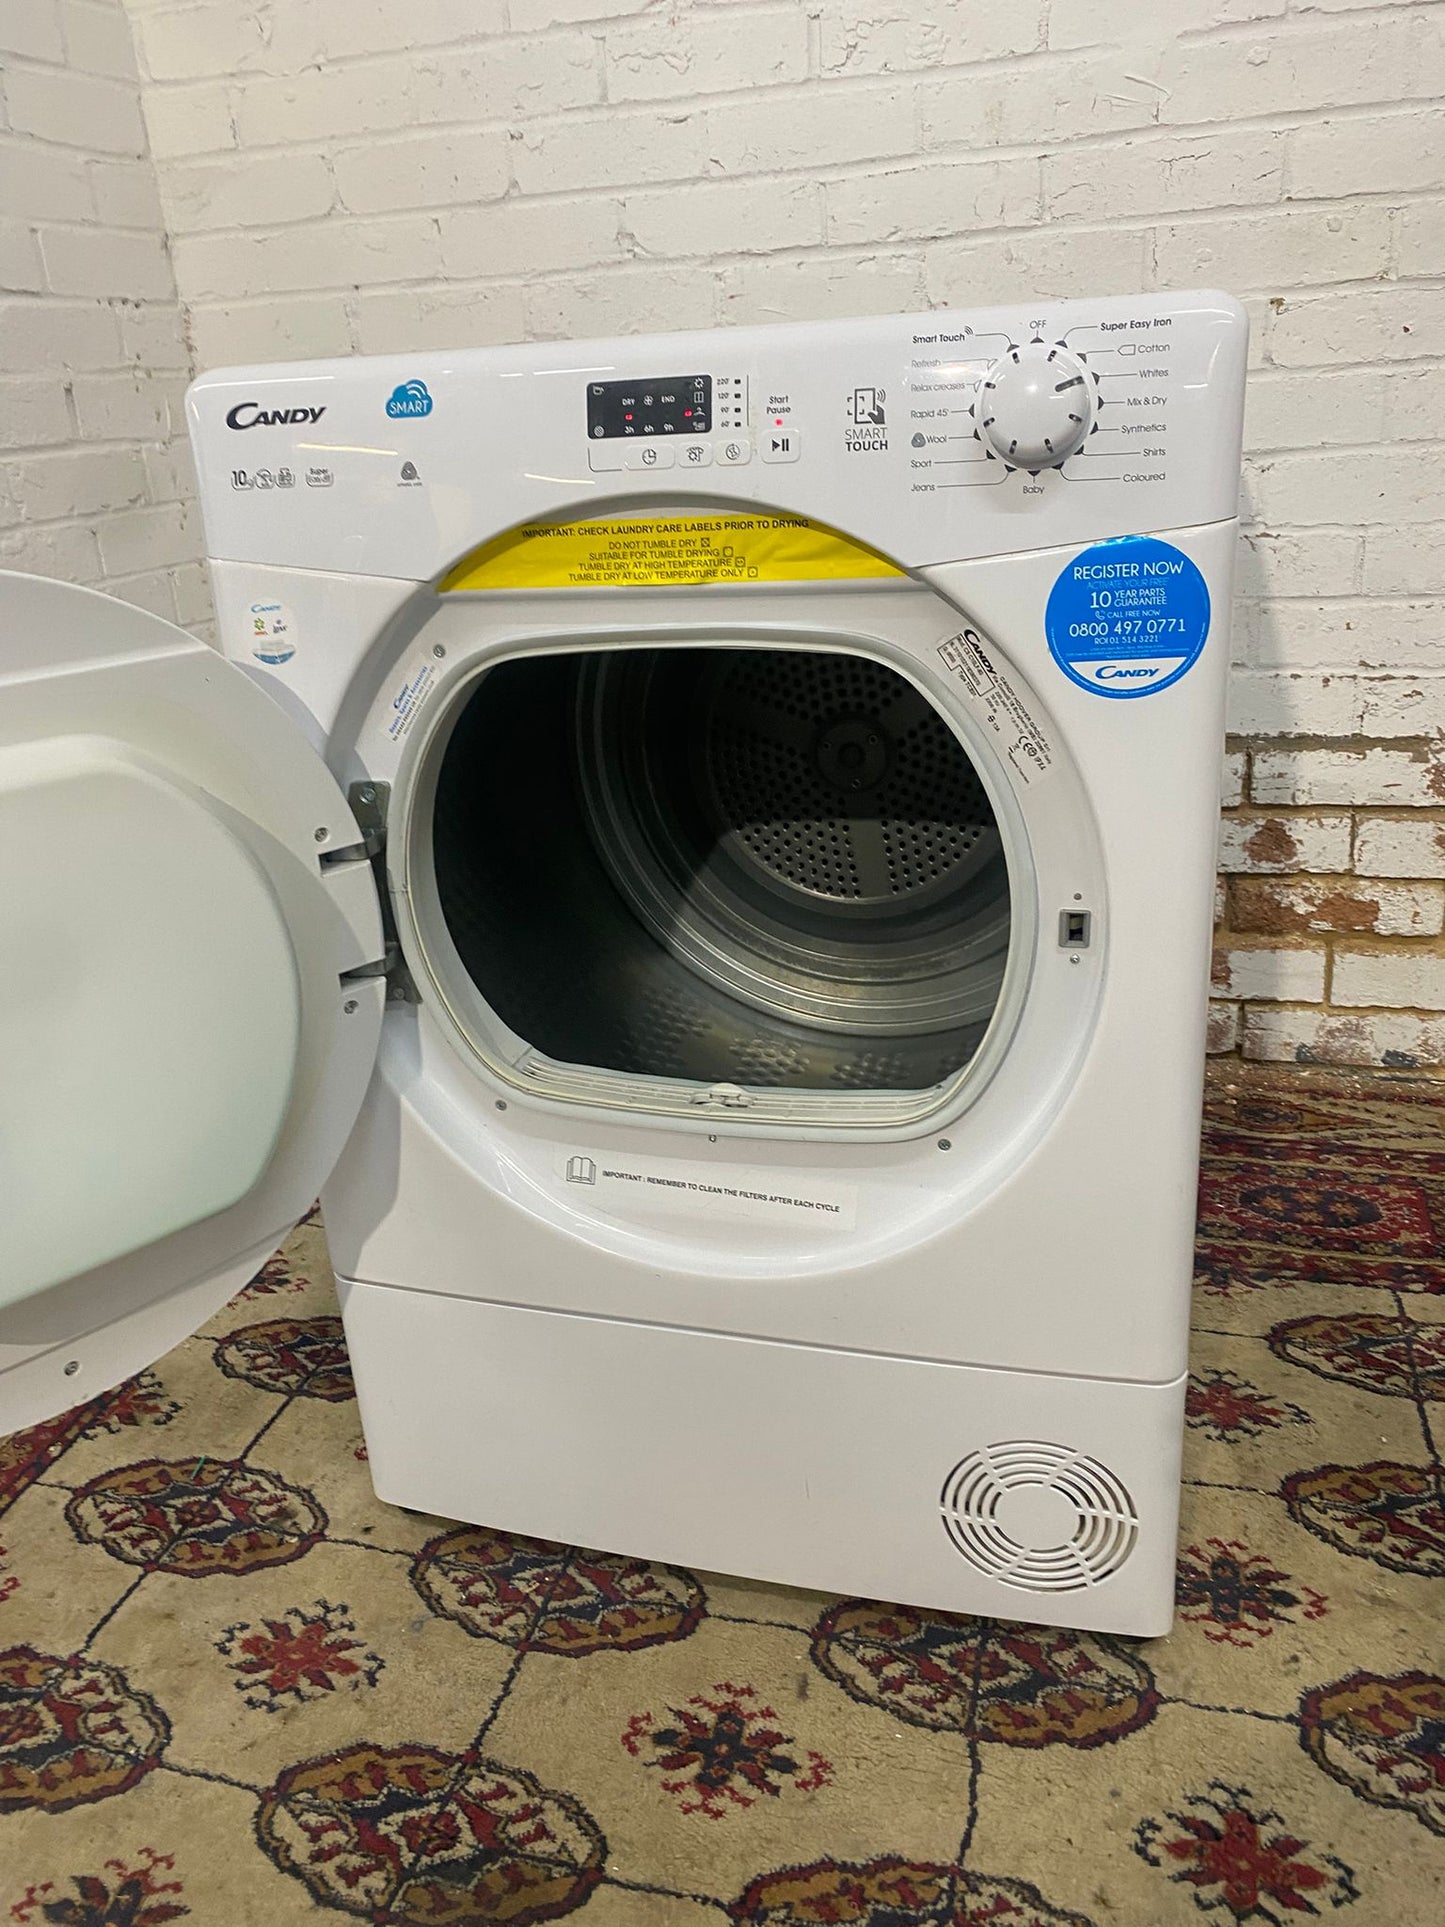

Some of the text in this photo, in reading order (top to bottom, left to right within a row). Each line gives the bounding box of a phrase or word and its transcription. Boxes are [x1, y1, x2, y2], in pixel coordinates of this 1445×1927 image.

[1029, 320, 1047, 329] OFF
[1100, 317, 1172, 332] Super Easy Iron
[912, 334, 965, 344] Smart Touch
[1137, 343, 1170, 353] Cotton
[1139, 368, 1169, 378] Whites
[911, 383, 965, 392] Relax creases
[622, 398, 635, 406] DRY
[769, 395, 789, 404] Start
[1127, 396, 1167, 407] Mix & Dry
[390, 400, 429, 414] SMART
[766, 405, 791, 414] Pause
[226, 403, 327, 431] CANDY
[911, 410, 935, 419] Rapid
[1121, 423, 1167, 433] Synthetics
[845, 428, 887, 441] SMART
[926, 434, 947, 444] Wool
[845, 440, 888, 452] TOUCH
[1143, 447, 1166, 456] Shirts
[910, 460, 932, 469] Sport
[1123, 472, 1166, 482] Coloured
[911, 483, 935, 492] Jeans
[1022, 485, 1045, 495] Baby
[522, 519, 809, 538] IMPORTANT: CHECK LAUNDRY CARE LABELS PRIOR TO DRYING
[609, 539, 697, 550] DO NOT TUMBLE DRY
[589, 548, 720, 561] SUITABLE FOR TUMBLE DRYING
[578, 558, 732, 571] TUMBLE DRY AT HIGH TEMPERATURE
[568, 568, 743, 582] TUMBLE DRY AT LOW TEMPERATURE ONLY
[1073, 561, 1184, 580] REGISTER NOW
[1114, 587, 1165, 598] YEAR PARTS
[1090, 591, 1112, 609] 10
[1114, 596, 1167, 607] GUARANTEE
[1142, 609, 1161, 617] NOW
[1069, 618, 1186, 637] 0800 497 0771
[1109, 636, 1119, 644] 01
[1139, 635, 1159, 643] 3221
[964, 629, 997, 675] CANDY
[1095, 665, 1160, 680] CANDY
[602, 1170, 642, 1182] IMPORTANT
[647, 1177, 686, 1189] REMEMBER
[699, 1185, 722, 1194] CLEAN
[724, 1188, 738, 1197] THE
[739, 1190, 767, 1201] FILTERS
[769, 1195, 793, 1205] AFTER
[794, 1199, 814, 1208] EACH
[815, 1203, 840, 1213] CYCLE
